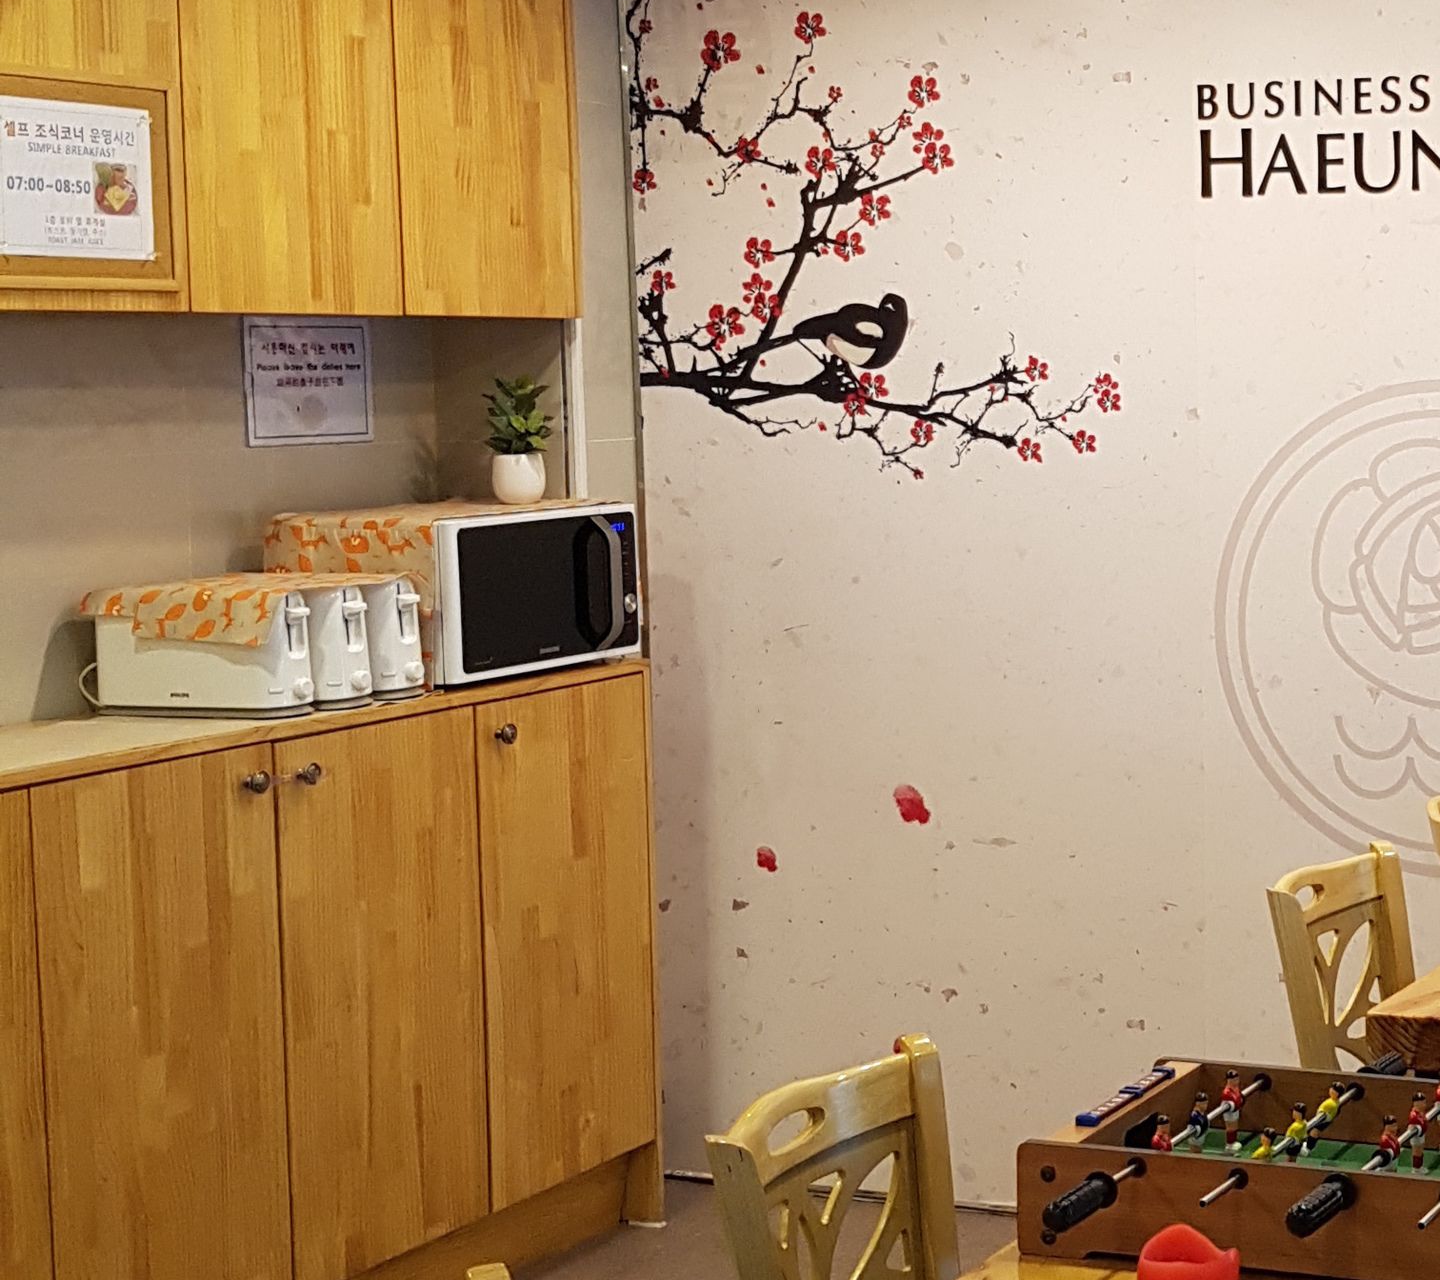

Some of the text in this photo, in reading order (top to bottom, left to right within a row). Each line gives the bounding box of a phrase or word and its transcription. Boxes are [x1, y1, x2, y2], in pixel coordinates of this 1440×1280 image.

[1197, 74, 1431, 120] BUSINESS
[4, 120, 135, 147] 셀프 조식코너 운영시간
[28, 141, 116, 158] SIMPLE BREAKFAST
